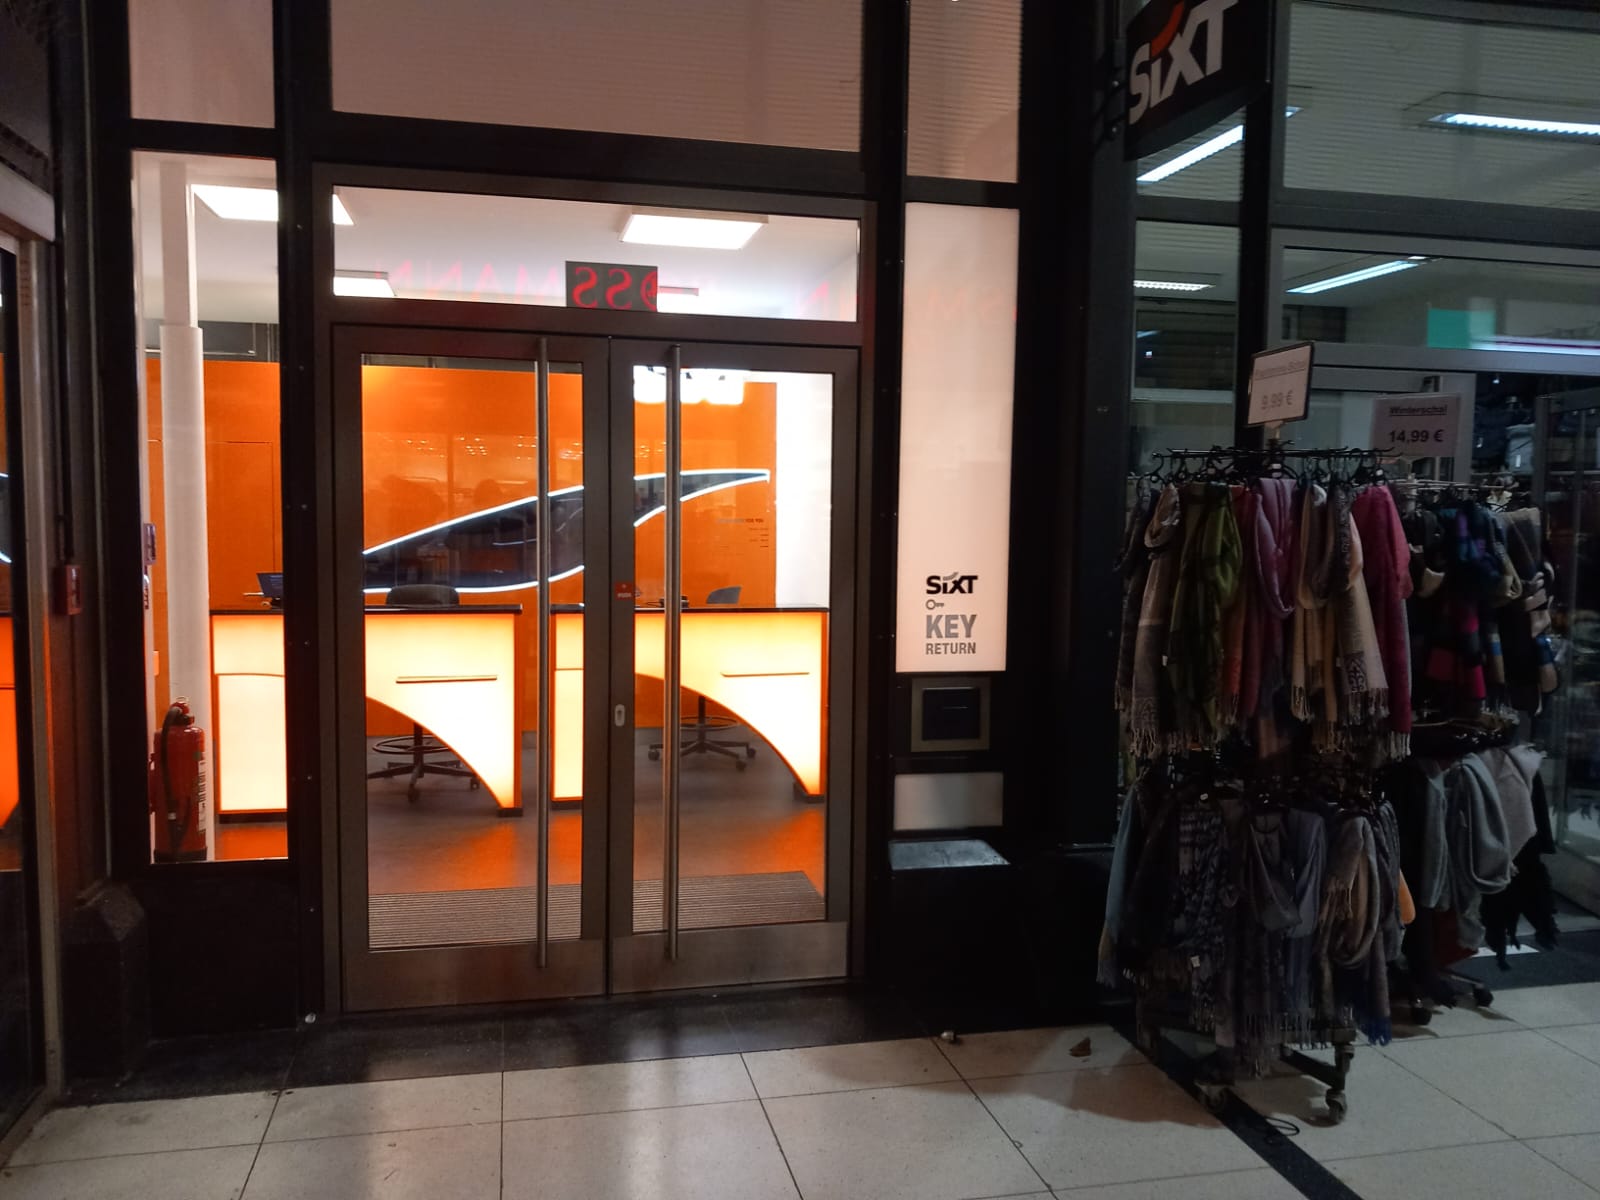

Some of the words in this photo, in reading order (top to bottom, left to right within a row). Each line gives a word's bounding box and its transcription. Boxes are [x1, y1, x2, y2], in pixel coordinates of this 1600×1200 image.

[1389, 430, 1430, 445] 14,99
[1433, 429, 1446, 443] €
[926, 614, 977, 639] KEY
[926, 642, 976, 655] RETURN
